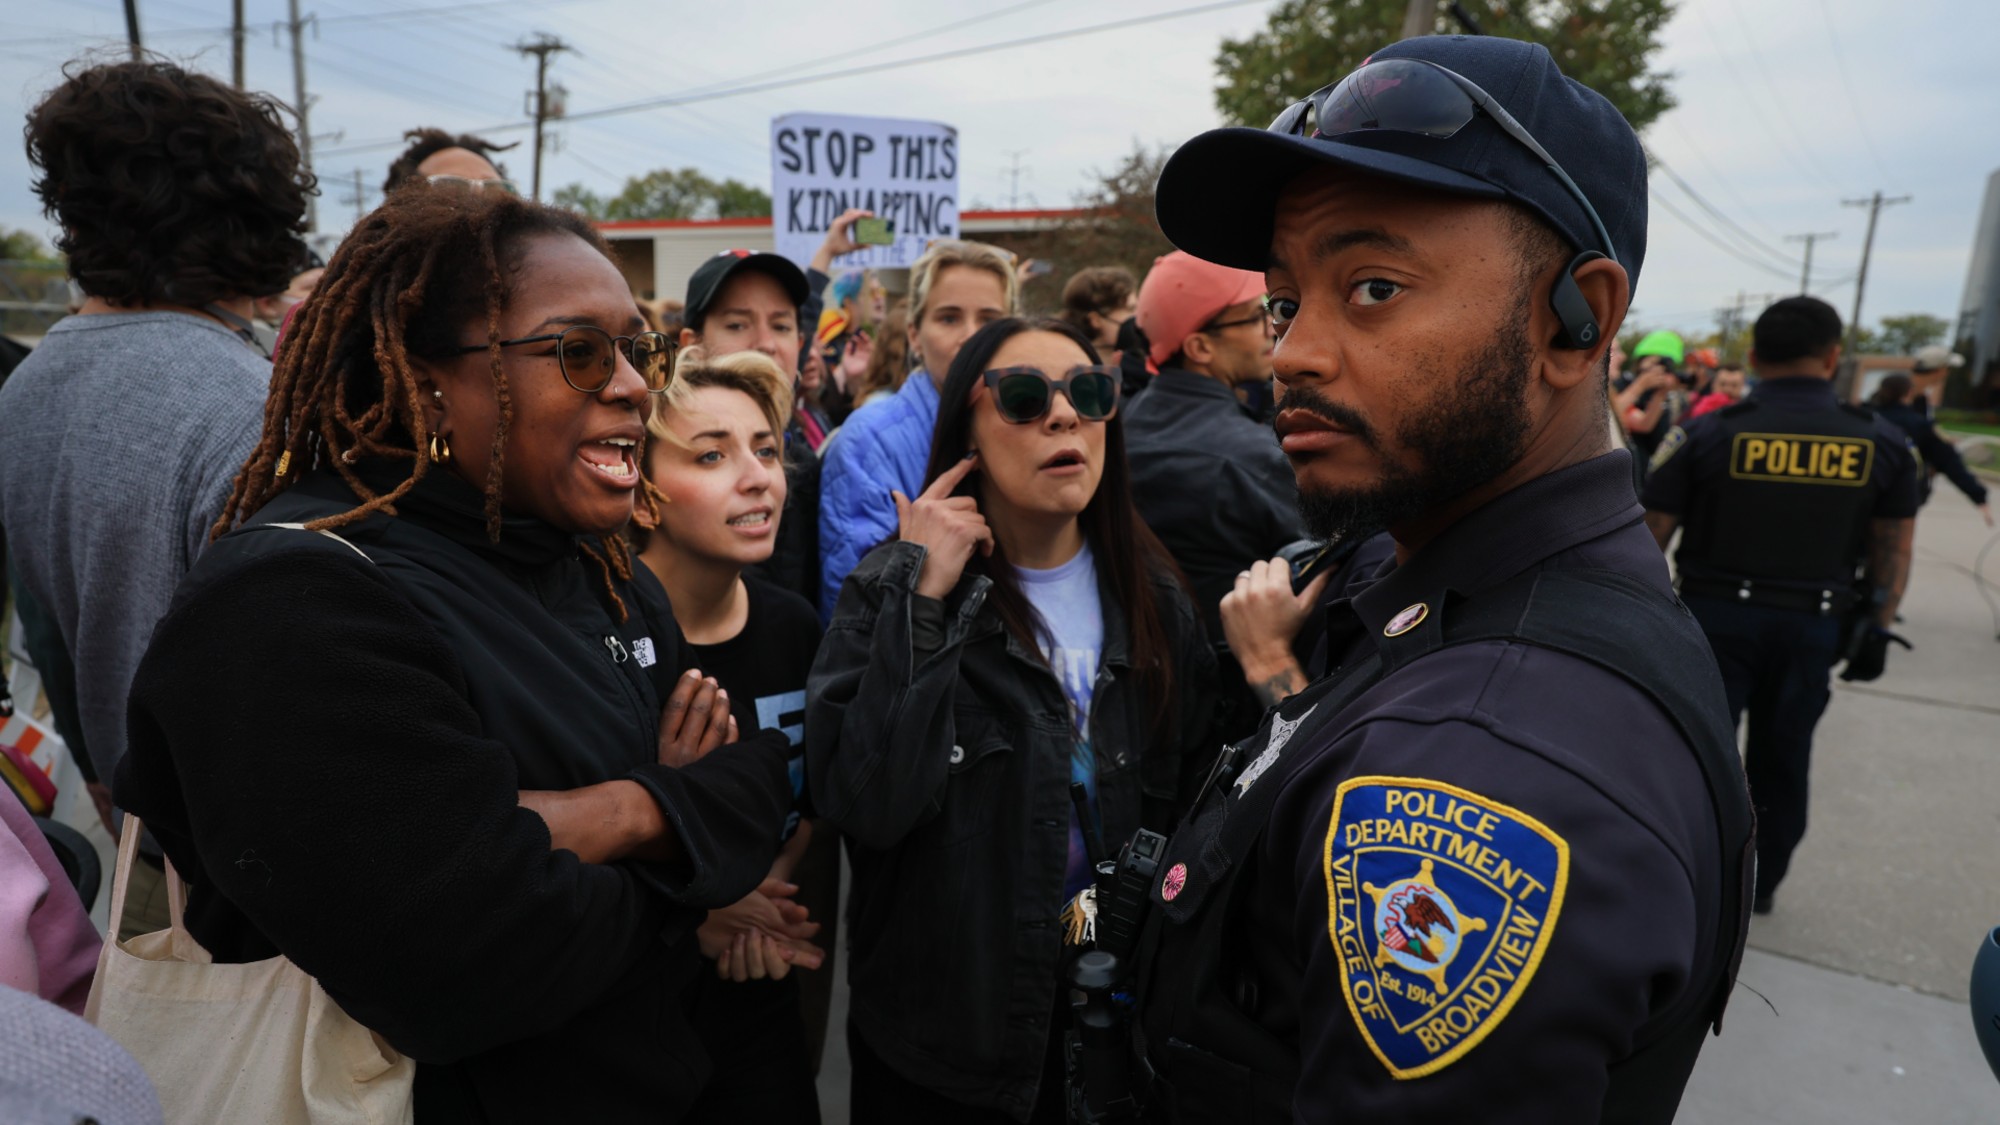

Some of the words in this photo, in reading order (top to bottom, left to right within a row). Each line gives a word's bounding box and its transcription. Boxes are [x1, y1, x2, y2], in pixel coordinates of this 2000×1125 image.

[776, 127, 875, 179] STOP
[888, 133, 957, 181] THIS
[1744, 439, 1862, 479] POLICE
[1386, 790, 1501, 841] POLICE
[1345, 819, 1546, 900] DEPARTMENT
[1332, 855, 1368, 974] VILLAGE
[1353, 979, 1385, 1020] OF
[1380, 970, 1403, 996] Est.
[1406, 982, 1438, 1008] 1914
[1415, 905, 1540, 1054] BROADVIEW
